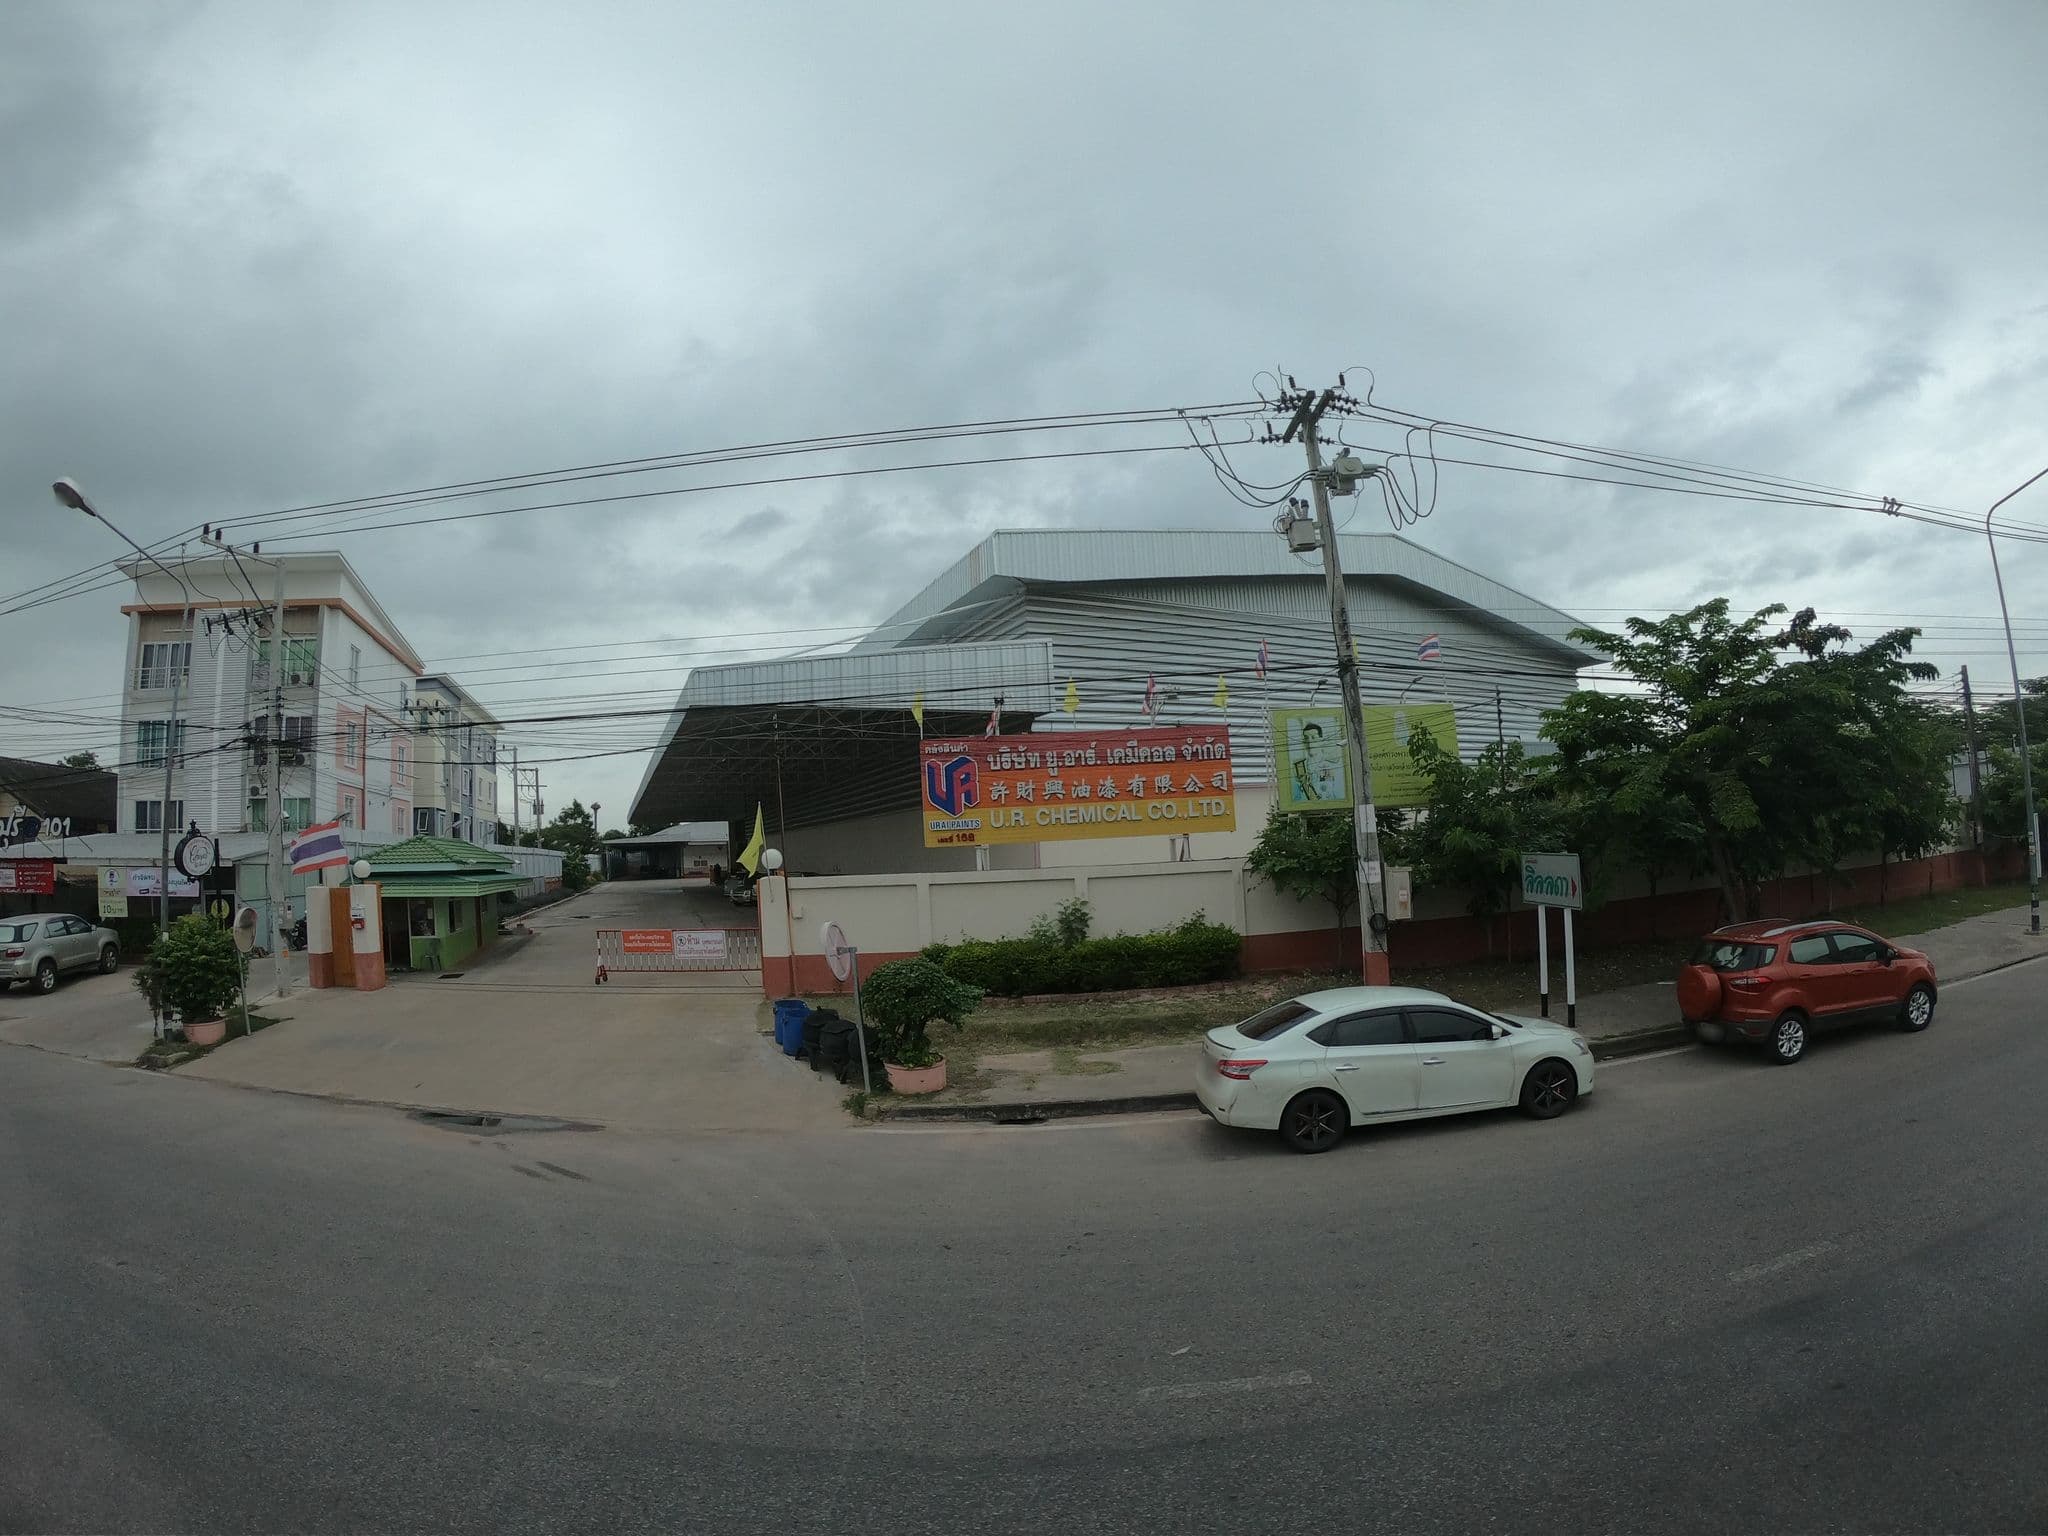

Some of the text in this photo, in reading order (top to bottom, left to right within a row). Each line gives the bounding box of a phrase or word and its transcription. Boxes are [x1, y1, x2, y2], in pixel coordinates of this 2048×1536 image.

[987, 736, 1226, 776] บริษัท ยู.อาร์. เคมีคอล จำกัด
[40, 816, 71, 837] 101
[990, 808, 1030, 828] U.R.
[1036, 803, 1143, 825] CHEMICAL
